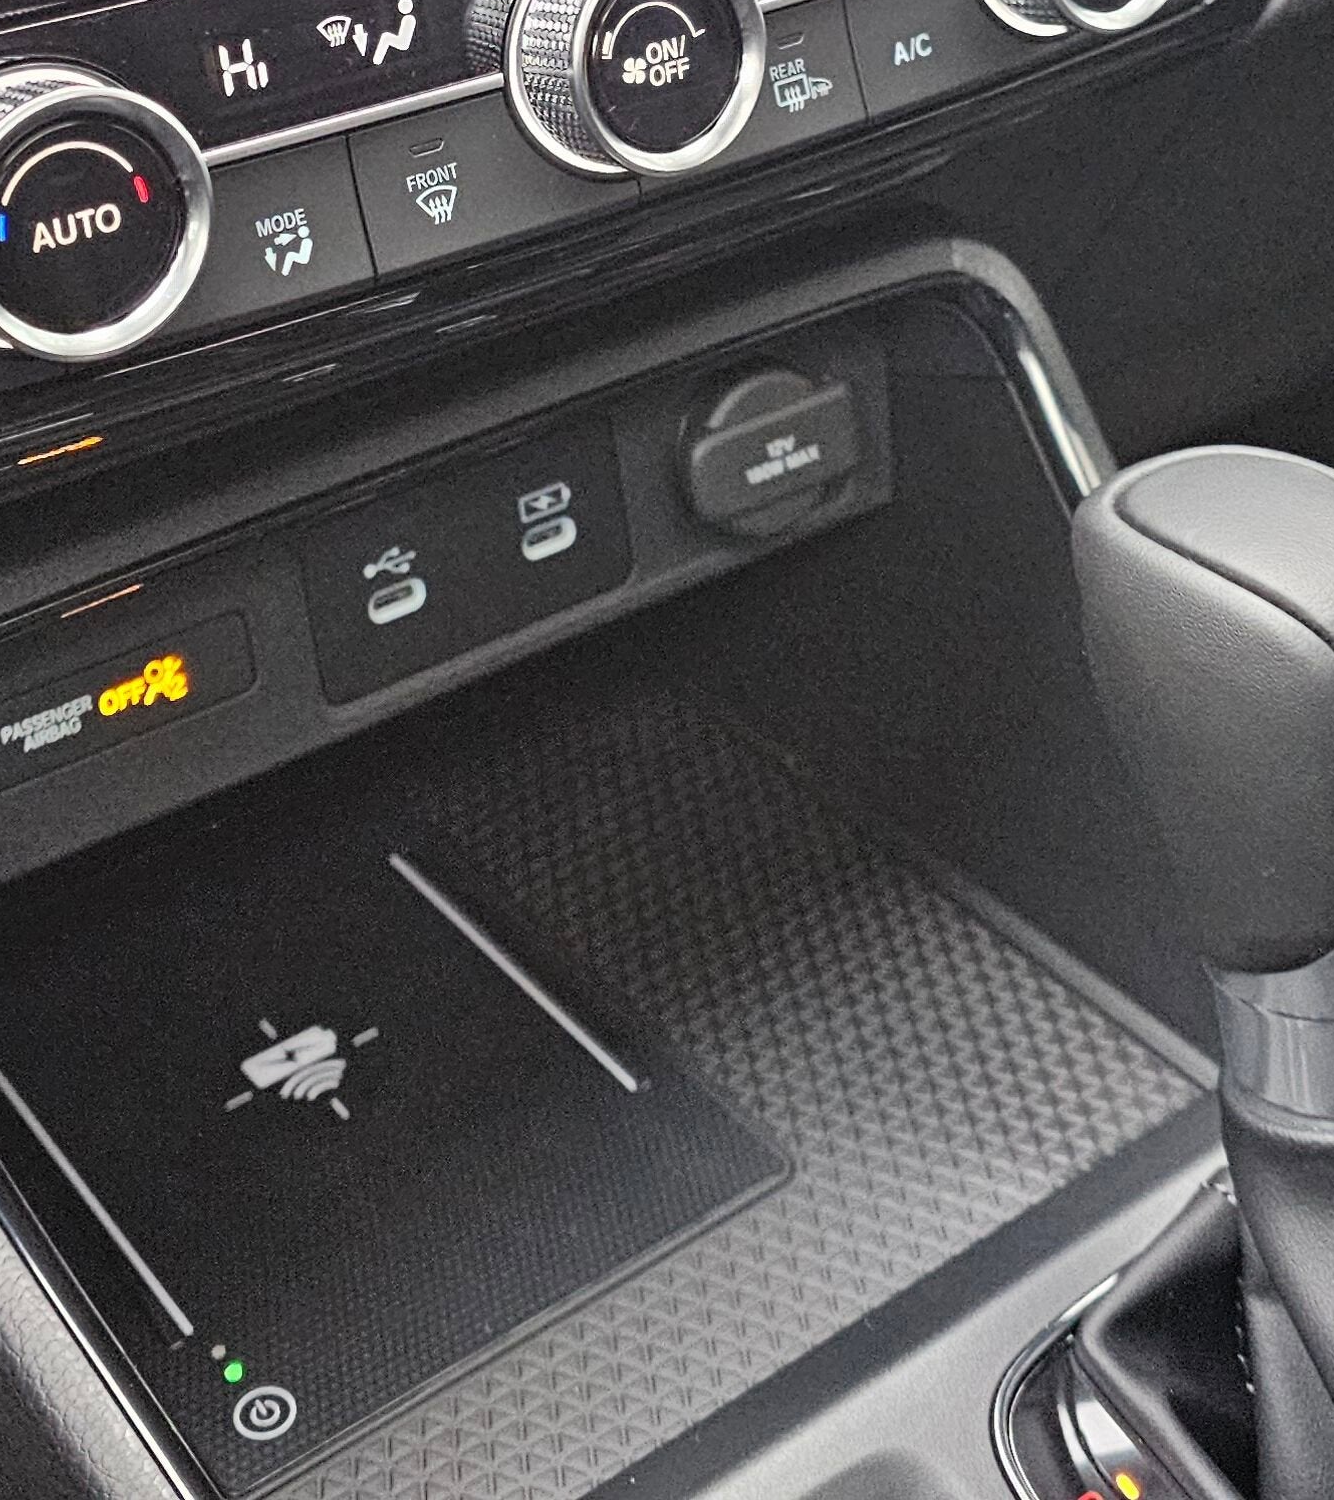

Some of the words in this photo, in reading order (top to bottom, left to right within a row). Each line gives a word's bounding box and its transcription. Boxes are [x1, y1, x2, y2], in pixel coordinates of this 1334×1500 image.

[645, 33, 687, 64] ON/
[892, 32, 934, 67] A/C
[649, 55, 692, 88] OFF
[768, 57, 806, 83] REAR
[405, 161, 459, 193] FRONT
[31, 203, 122, 254] AUTO
[255, 207, 308, 238] MODE
[0, 694, 94, 745] PASSENGER
[98, 676, 147, 717] OFF
[23, 716, 83, 753] AIRBAG
